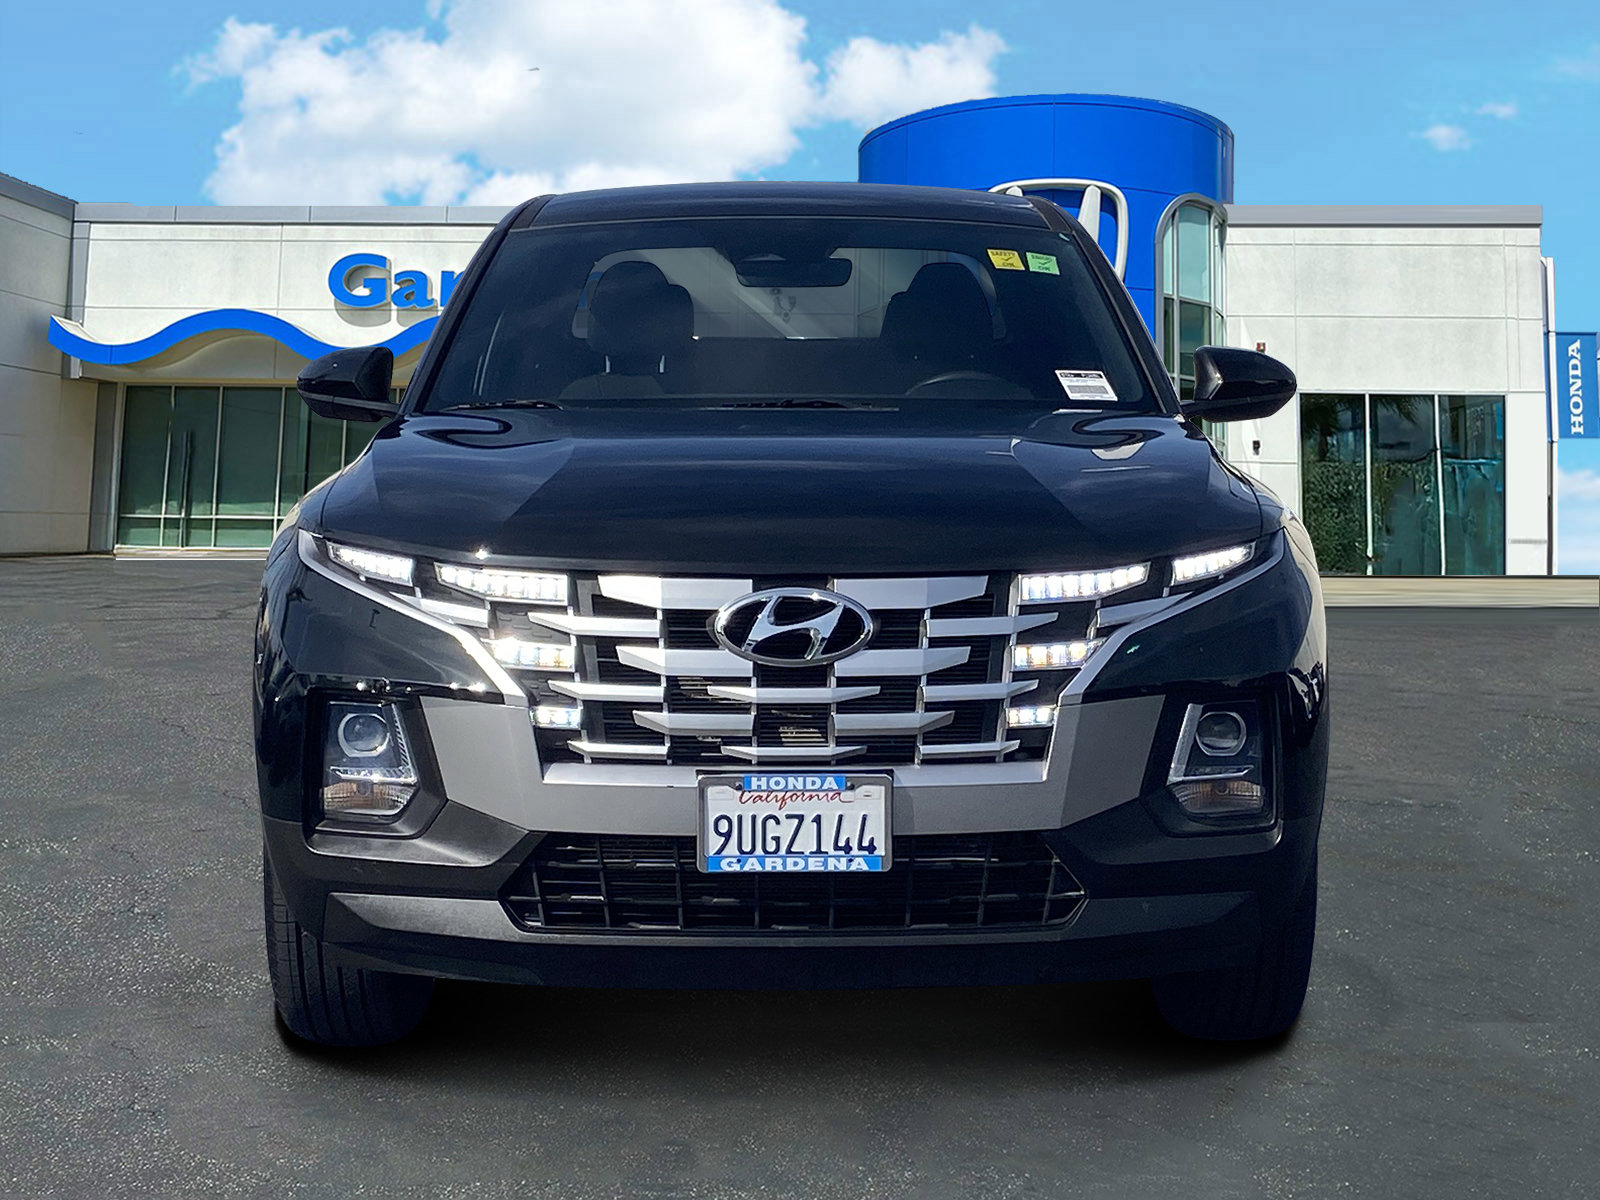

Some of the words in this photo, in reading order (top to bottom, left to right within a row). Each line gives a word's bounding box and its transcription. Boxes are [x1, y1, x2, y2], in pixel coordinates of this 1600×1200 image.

[1568, 339, 1584, 435] HONDA
[751, 776, 839, 790] HONDA
[713, 814, 878, 855] 9UGZ144
[720, 857, 869, 871] GARDENA
